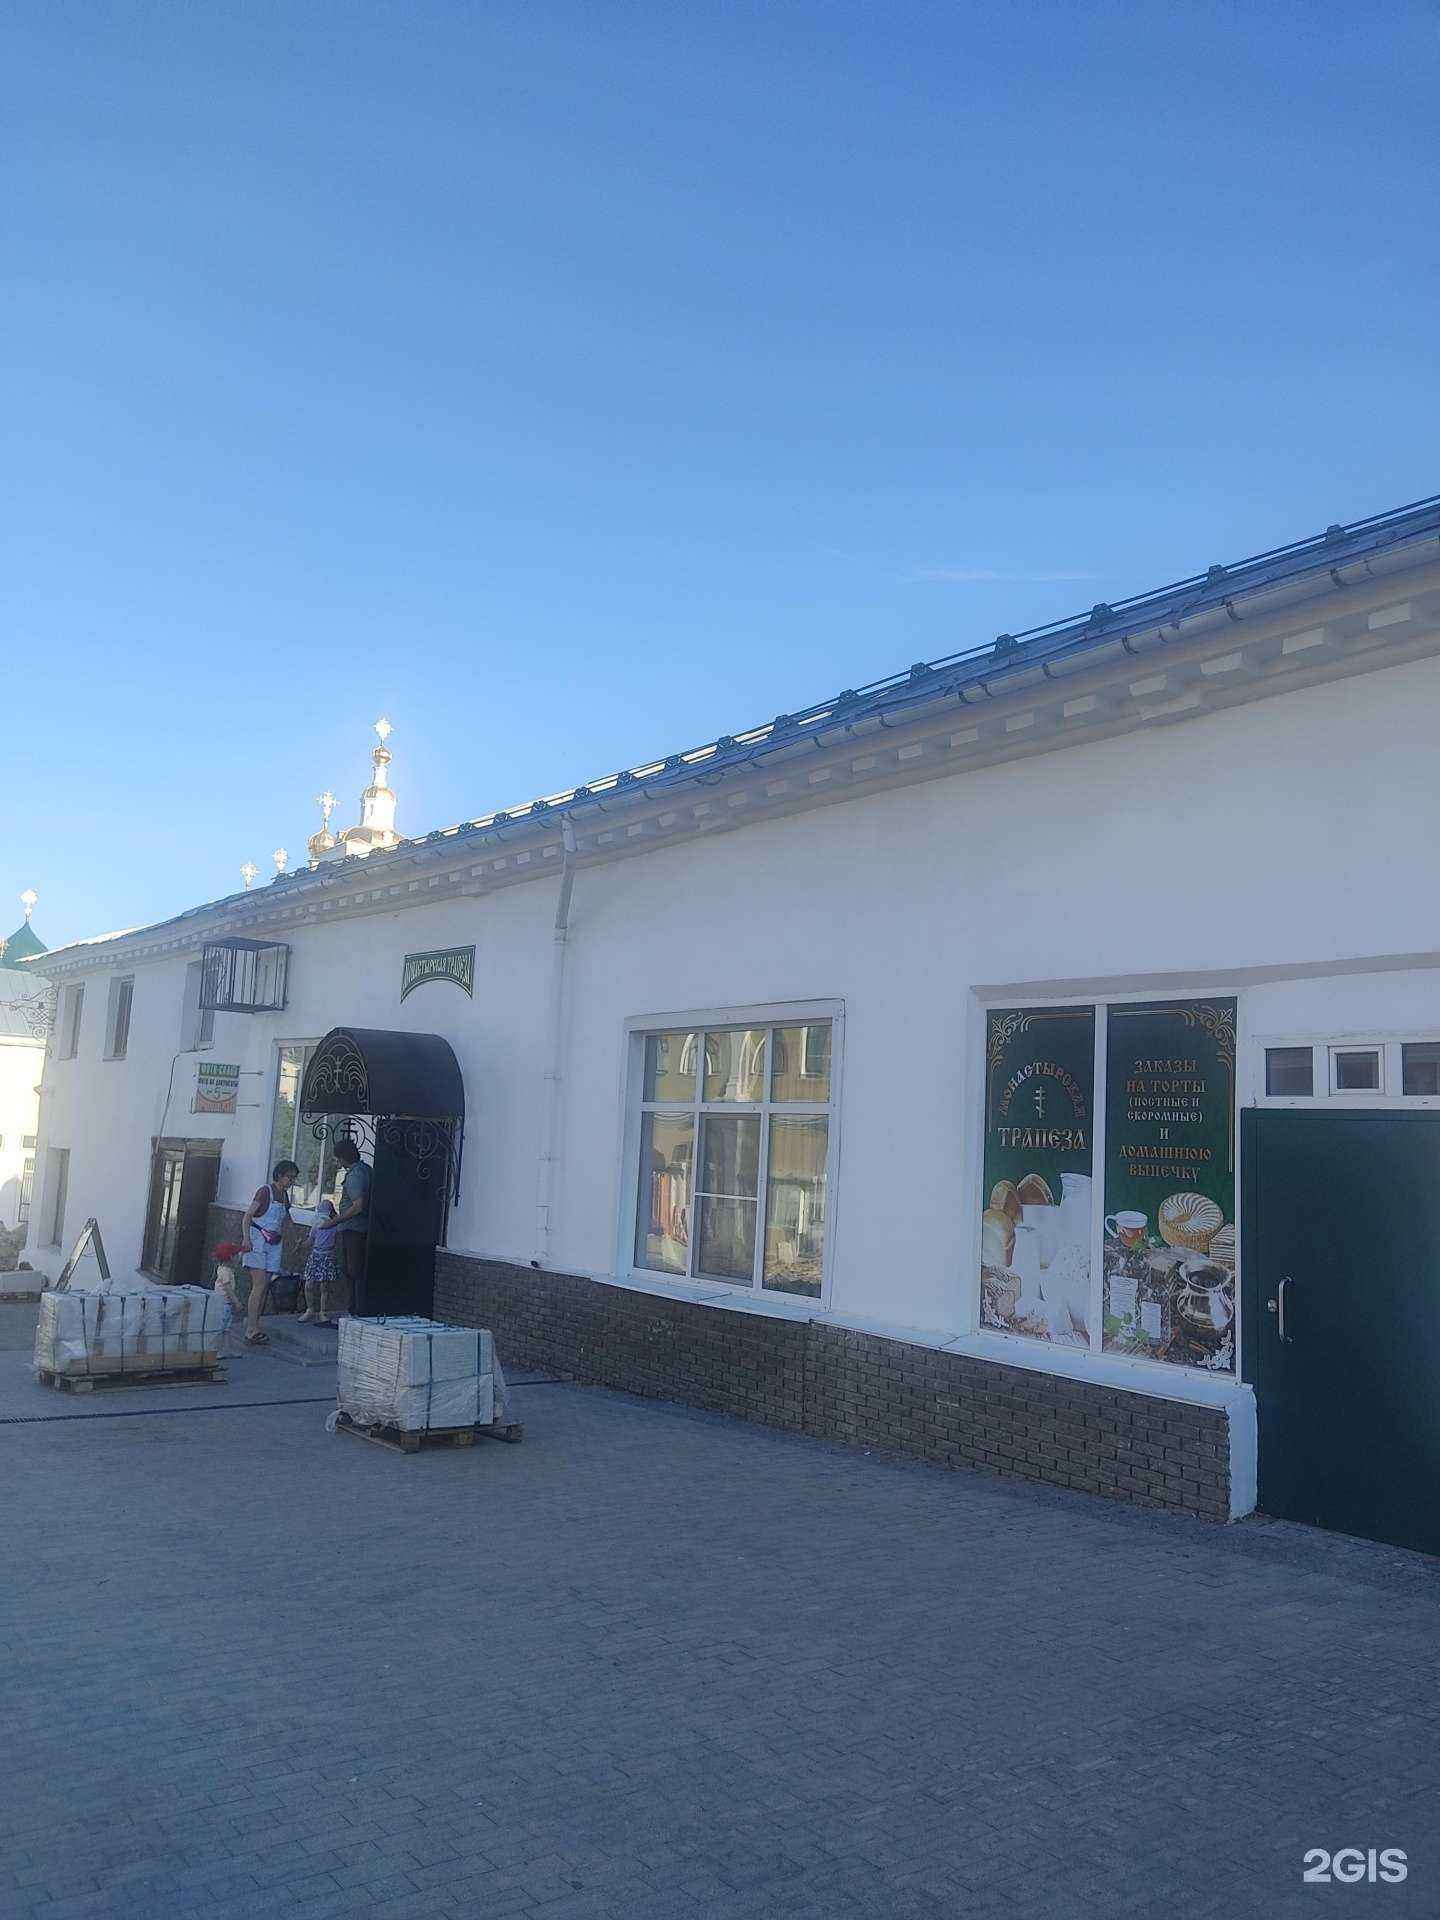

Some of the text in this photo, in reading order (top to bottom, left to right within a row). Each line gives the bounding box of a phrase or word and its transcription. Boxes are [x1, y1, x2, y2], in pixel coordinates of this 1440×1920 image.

[1134, 1060, 1198, 1073] ЗАКАЗЫ
[1000, 1062, 1086, 1120] МОНАСТЫРСКАЯ
[1127, 1080, 1207, 1093] НА ТОРТЫ
[1129, 1096, 1199, 1107] (ПОСТНЫЕ И
[1127, 1111, 1203, 1123] СКОРОМНЫЕ)
[998, 1127, 1088, 1151] ТРАПЕЗА
[1160, 1127, 1169, 1140] И
[1119, 1145, 1211, 1160] ДОМАШНЮЮ
[1129, 1163, 1200, 1183] ВЫПЕЧКУ
